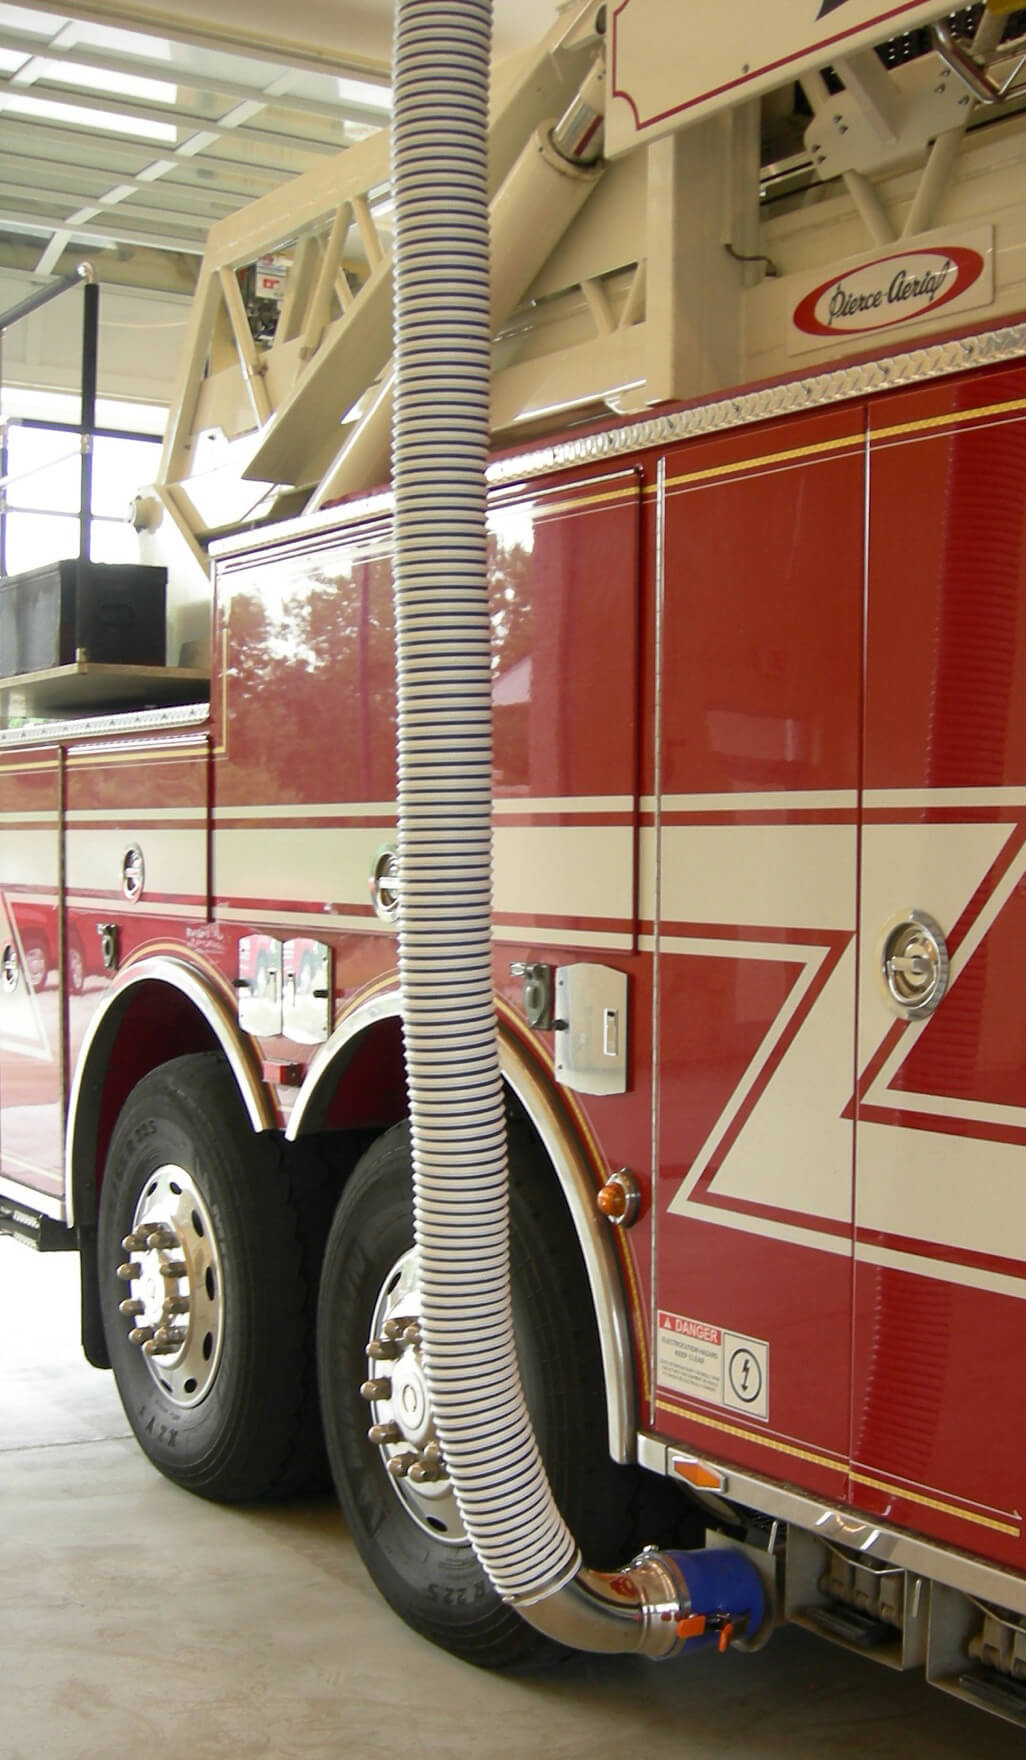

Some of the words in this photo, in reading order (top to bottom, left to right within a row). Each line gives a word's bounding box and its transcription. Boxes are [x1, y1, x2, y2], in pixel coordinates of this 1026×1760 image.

[828, 281, 883, 327] Pierce
[888, 259, 951, 304] Aerial
[675, 1318, 719, 1344] DANGER
